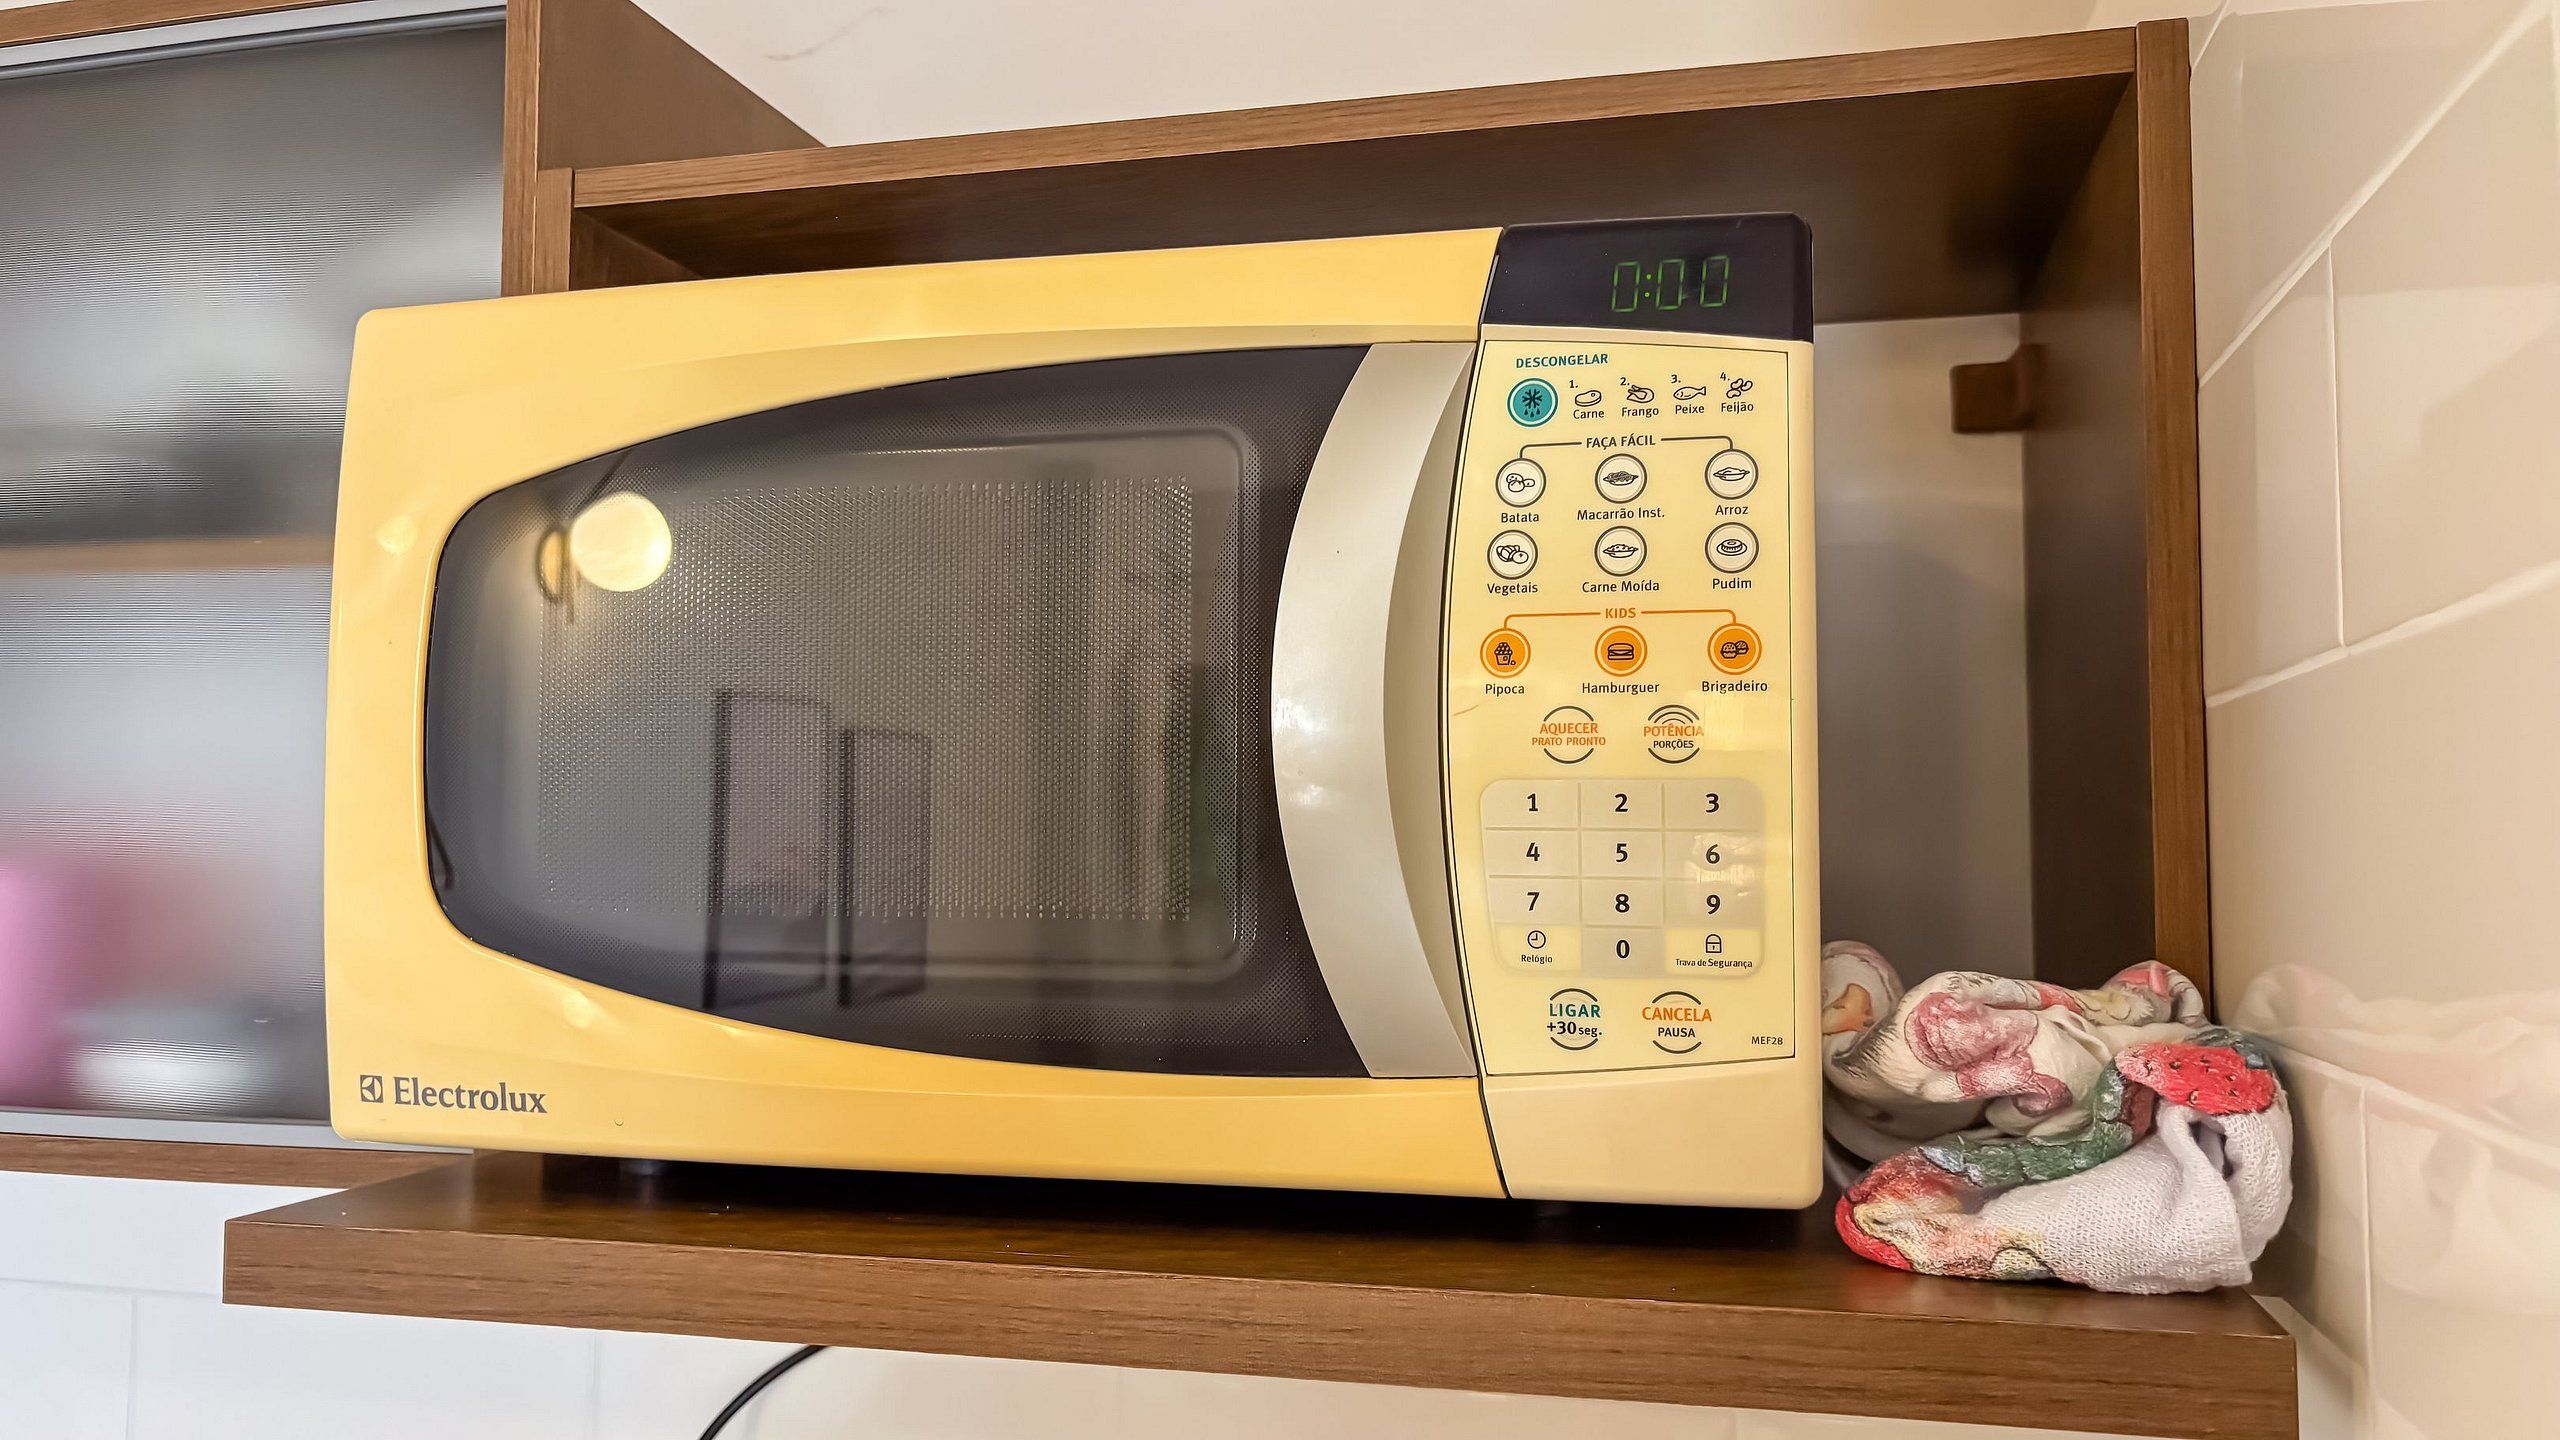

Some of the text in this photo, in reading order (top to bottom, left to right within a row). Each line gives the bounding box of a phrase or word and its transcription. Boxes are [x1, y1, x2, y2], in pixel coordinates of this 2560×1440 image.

[1516, 353, 1608, 368] DESCONGELAR
[1573, 409, 1605, 418] Carne
[1621, 406, 1659, 418] Frango
[1675, 404, 1705, 414] Peixe
[1721, 401, 1754, 414] Feijão
[1586, 434, 1656, 449] FAÇA FÁCIL
[1577, 507, 1665, 521] Macarrão Inst.
[1715, 505, 1749, 515] Arroz
[1501, 512, 1539, 523] Batata
[1487, 582, 1538, 595] Vegetais
[1582, 580, 1660, 593] Carne Moída
[1712, 578, 1752, 589] Pudim
[1605, 608, 1636, 619] KIDS
[1485, 684, 1525, 698] Pipoca
[1582, 682, 1659, 696] Hamburguer
[1702, 680, 1768, 694] Brigadeiro
[1540, 723, 1598, 736] AQUECER
[1643, 724, 1704, 737] POTÊNCIA
[1532, 736, 1606, 746] PRATO PRONTO
[1653, 738, 1694, 750] PORÇÕES
[1527, 794, 1538, 812] 1
[1615, 794, 1628, 812] 2
[1706, 794, 1719, 813] 3
[1526, 843, 1540, 862] 4
[1616, 843, 1628, 863] 5
[1706, 844, 1720, 864] 6
[1527, 892, 1540, 911] 7
[1615, 893, 1630, 913] 8
[1706, 894, 1720, 915] 9
[1616, 940, 1630, 959] 0
[1521, 954, 1553, 964] Relógio
[1675, 958, 1753, 970] Trava de Segurança
[1549, 1004, 1600, 1018] LIGAR
[1642, 1007, 1712, 1022] CANCELA
[1658, 1027, 1695, 1038] PAUSA
[1751, 1036, 1783, 1046] MEF28
[393, 1076, 547, 1114] Electrolux
